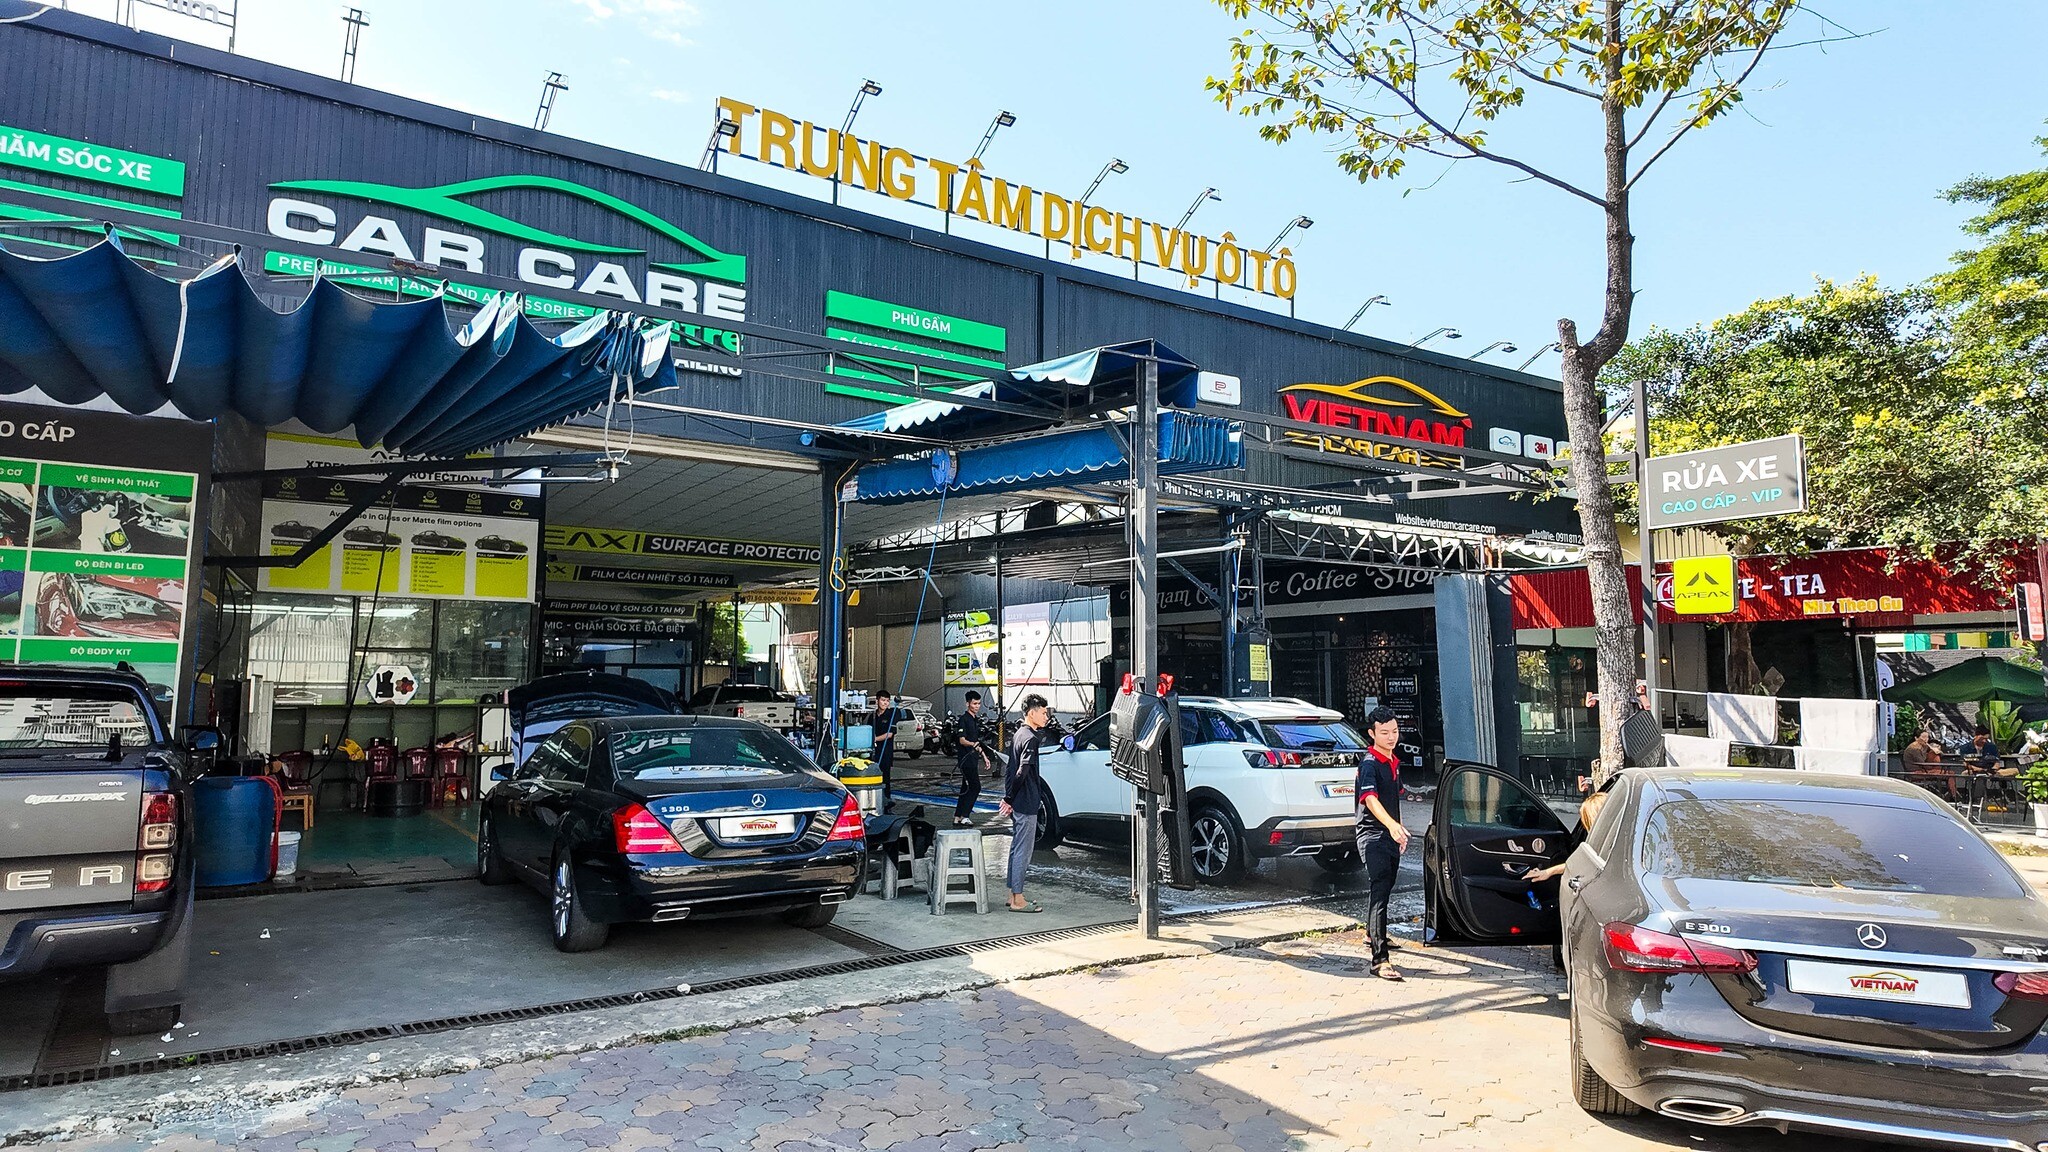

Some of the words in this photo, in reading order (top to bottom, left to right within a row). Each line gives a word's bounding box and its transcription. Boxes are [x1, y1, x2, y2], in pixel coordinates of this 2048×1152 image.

[56, 147, 112, 173] SÓC
[118, 158, 152, 182] XE
[719, 96, 916, 201] TRUNG
[929, 157, 1032, 234] TÂM
[1043, 192, 1142, 263] DỊCH
[1151, 222, 1208, 289] VỤ
[1214, 231, 1242, 285] Ô
[1248, 247, 1298, 299] TÔ
[267, 198, 485, 274] CAR
[518, 247, 746, 322] CARE
[892, 310, 920, 327] PHỦ
[922, 315, 951, 334] GẦM
[1283, 393, 1464, 448] VIETNAM
[22, 420, 76, 443] CẤP
[1535, 442, 1548, 454] 3M
[76, 474, 89, 483] VỆ
[90, 476, 115, 485] SINH
[117, 477, 134, 486] NỘI
[409, 472, 479, 482] ROTECTION
[1662, 460, 1729, 493] RỬA
[1735, 454, 1779, 483] XE
[1661, 499, 1697, 515] CAO
[1701, 490, 1737, 510] CẤP
[1751, 488, 1783, 503] VIP
[413, 517, 436, 525] Matte
[437, 518, 452, 526] film
[453, 520, 483, 528] options
[651, 537, 730, 556] SURFACE
[732, 543, 822, 562] PROTECTIO
[75, 559, 90, 568] ĐỘ
[591, 569, 615, 579] FILM
[617, 569, 645, 581] CÁCH
[647, 573, 676, 583] NHIỆT
[677, 573, 691, 582] SỐ
[699, 576, 713, 585] TẠI
[715, 576, 730, 585] MỸ
[1286, 570, 1358, 596] Coffee
[1779, 573, 1827, 596] TEA
[1676, 590, 1730, 599] APEAX
[550, 601, 569, 610] Film
[570, 602, 587, 610] PPF
[610, 604, 621, 613] VỆ
[622, 604, 640, 613] SƠN
[660, 606, 672, 615] TẠI
[1803, 599, 1835, 615] Mix
[1837, 597, 1879, 614] Theo
[1879, 595, 1903, 612] Gu
[544, 621, 563, 630] MIC
[606, 620, 627, 632] SÓC
[628, 623, 641, 632] XE
[643, 622, 664, 634] ĐẶC
[666, 623, 686, 634] BIỆT
[70, 646, 85, 656] ĐỘ
[116, 648, 132, 656] KIT
[668, 805, 690, 813] 300
[740, 822, 777, 830] VIETNAM
[1685, 921, 1696, 931] E
[1697, 923, 1731, 934] 300
[1850, 978, 1916, 992] VIETNAM
